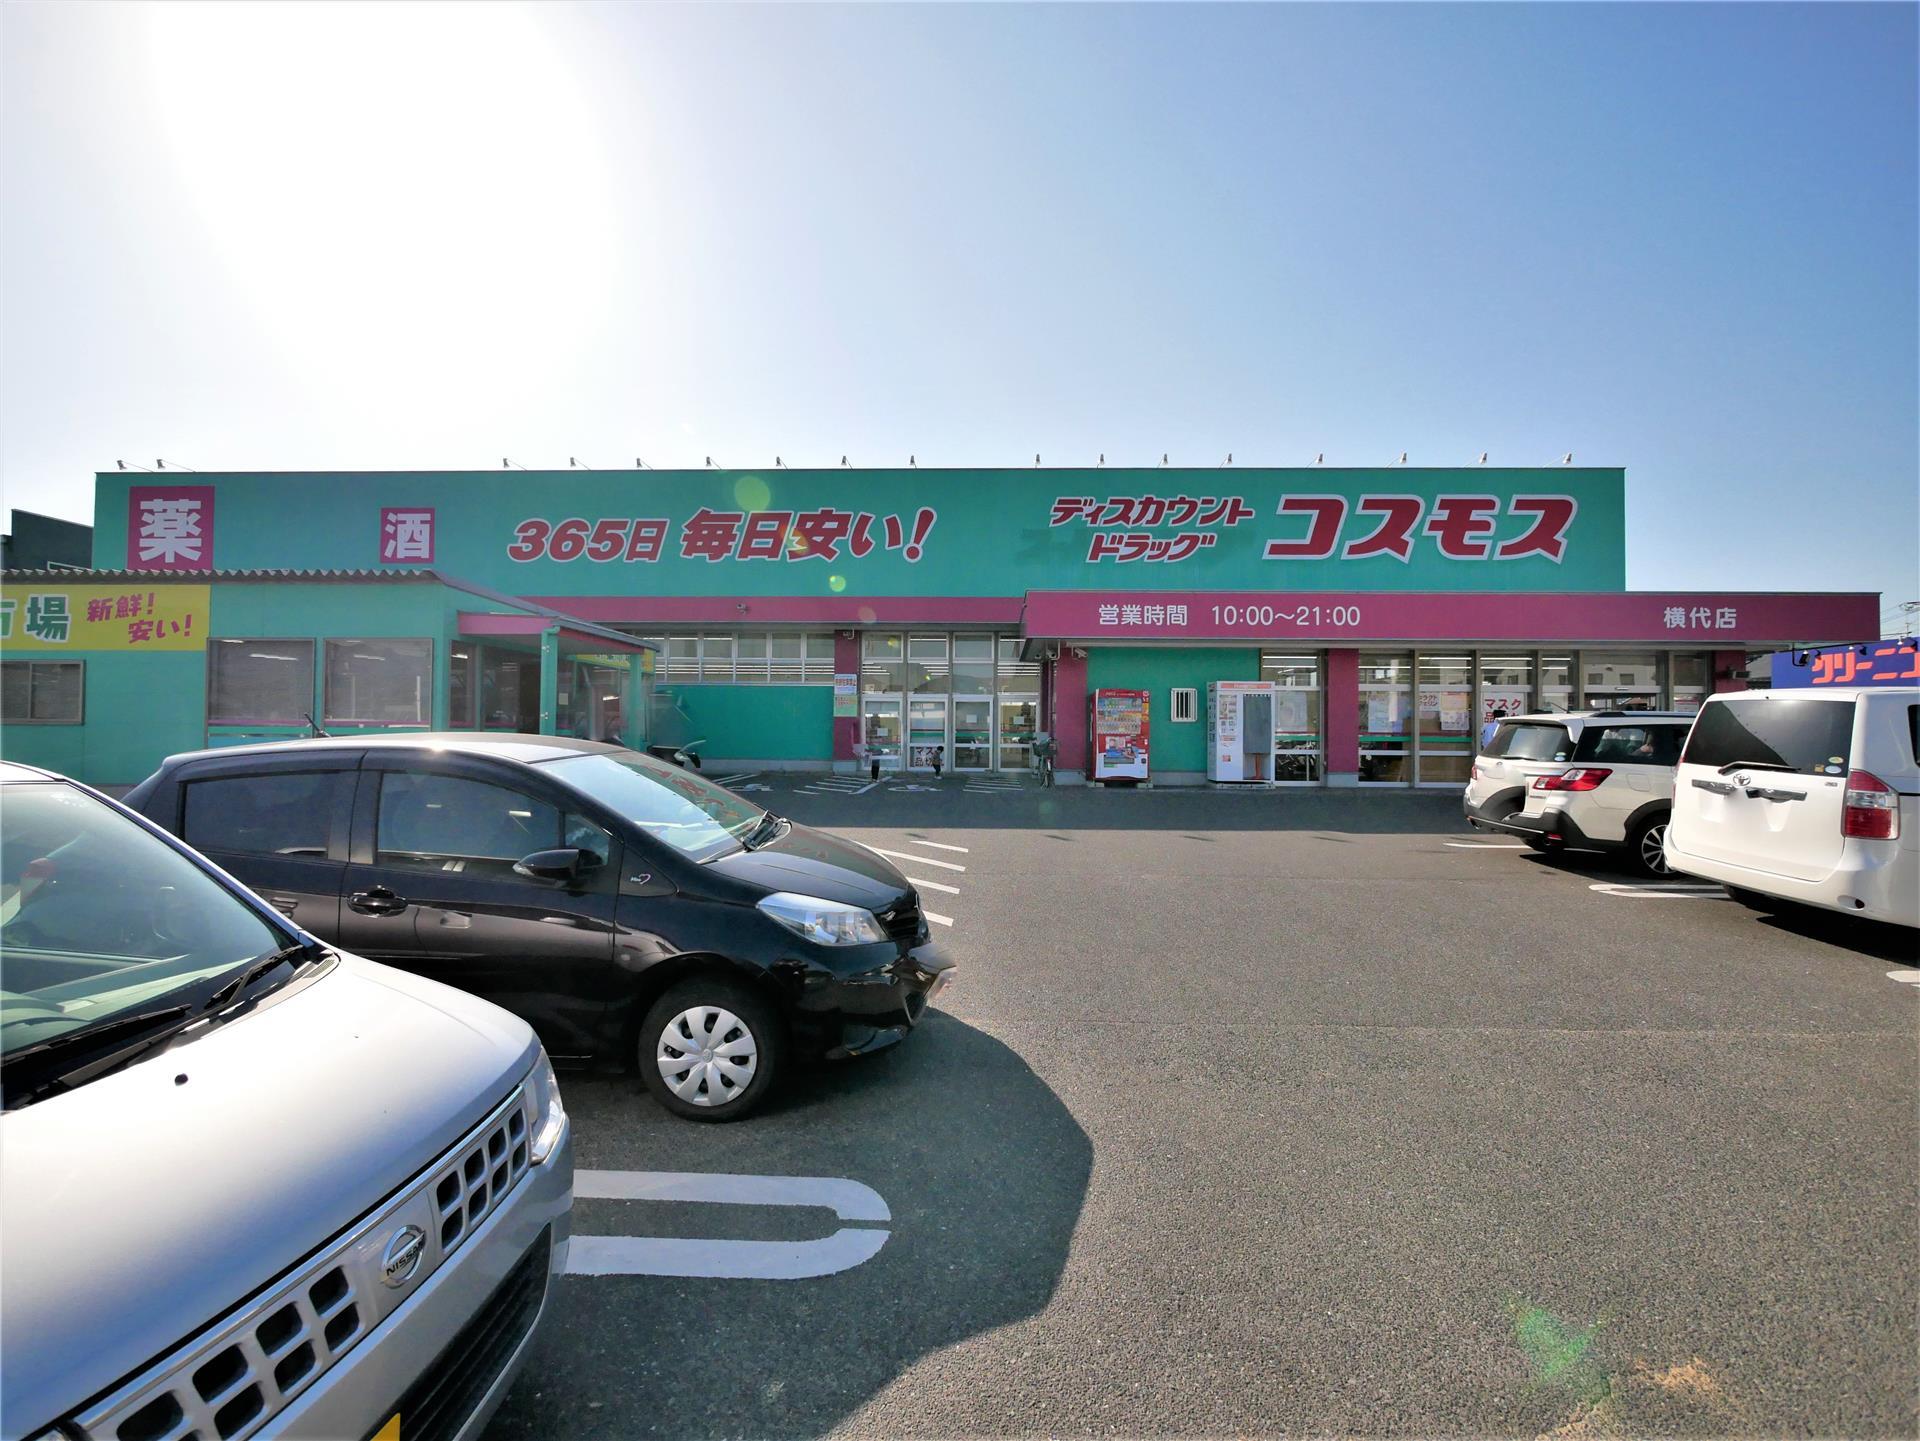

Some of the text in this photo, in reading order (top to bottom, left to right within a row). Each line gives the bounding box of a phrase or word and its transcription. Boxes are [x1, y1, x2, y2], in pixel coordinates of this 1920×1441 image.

[1049, 494, 1255, 527] ディスカウント
[138, 498, 202, 563] 薬
[384, 513, 431, 560] 酒
[507, 506, 938, 564] 365日 毎日安い!
[1262, 494, 1578, 564] コスモス
[1086, 532, 1217, 563] ドラッグ
[1098, 604, 1188, 626] 営業時間
[1663, 606, 1737, 629] 横代店
[1484, 698, 1522, 710] マスク
